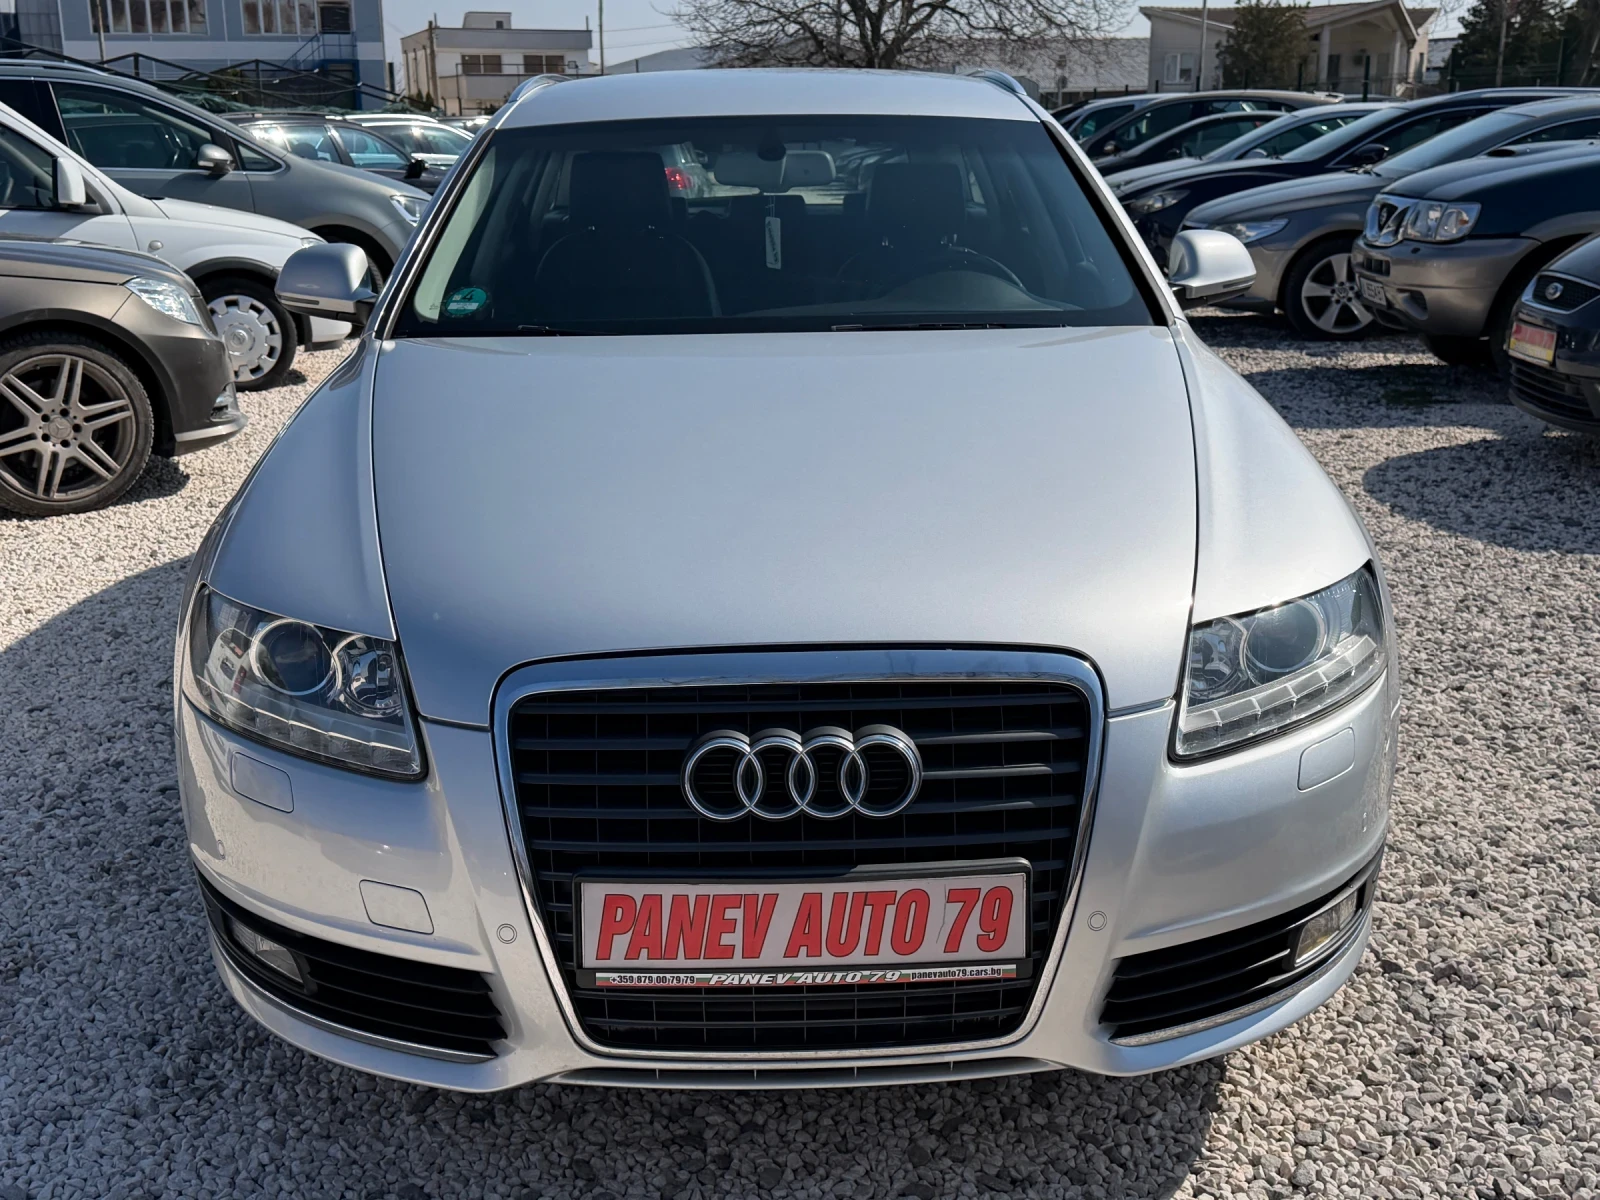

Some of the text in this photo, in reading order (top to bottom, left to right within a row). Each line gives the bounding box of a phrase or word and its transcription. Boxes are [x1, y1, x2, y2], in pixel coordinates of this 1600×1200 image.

[461, 289, 475, 302] 4
[595, 885, 1014, 960] PANEV AUTO 79
[611, 974, 695, 984] +359 879 00 79 79
[708, 970, 902, 985] PANEV AUTO 79
[911, 967, 1001, 980] panevauto79.cars.bg
